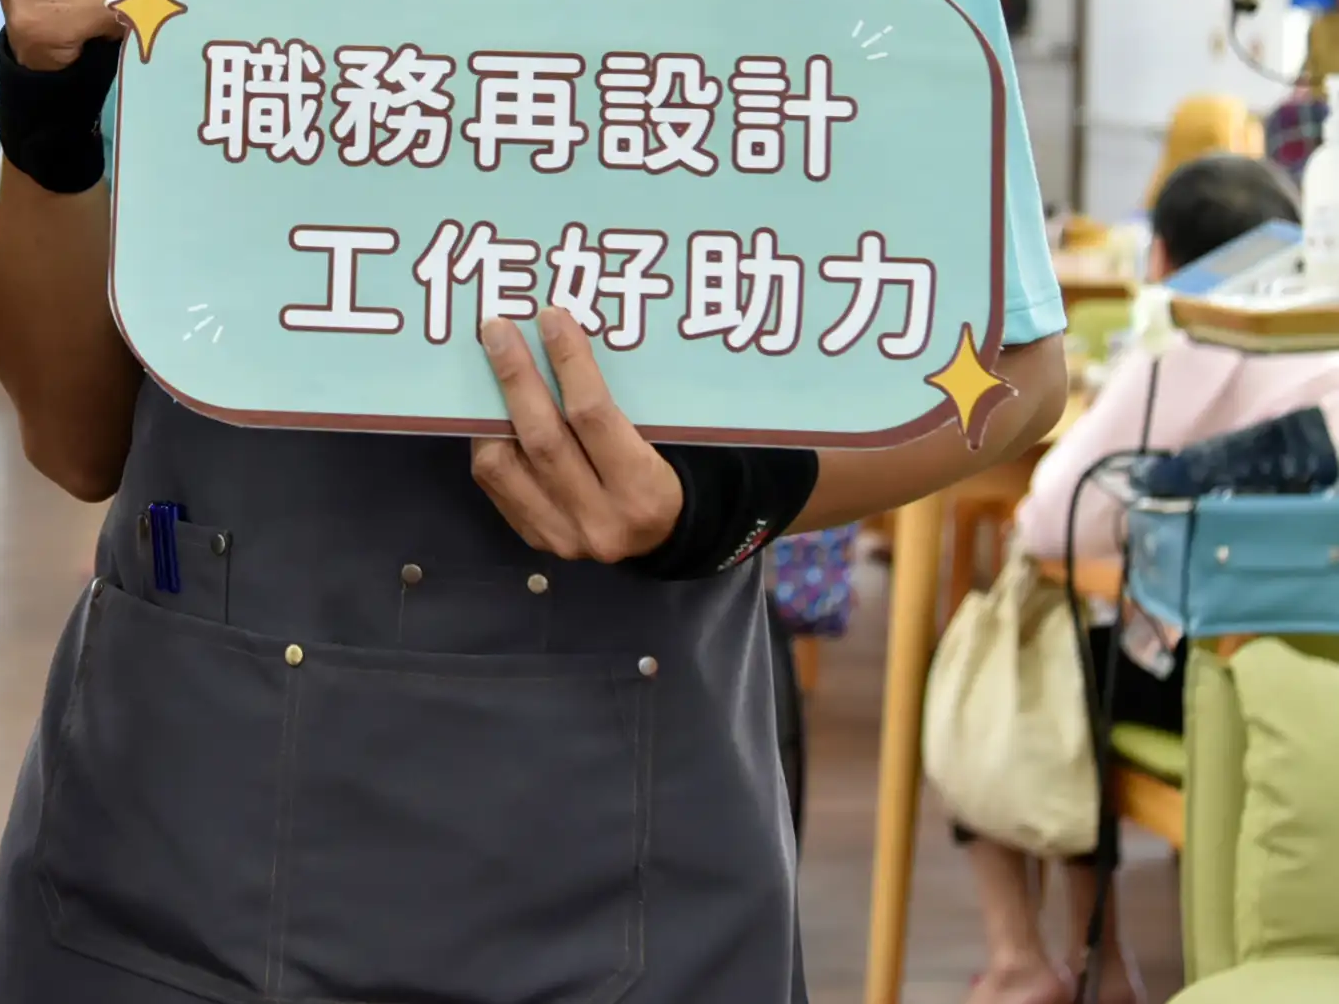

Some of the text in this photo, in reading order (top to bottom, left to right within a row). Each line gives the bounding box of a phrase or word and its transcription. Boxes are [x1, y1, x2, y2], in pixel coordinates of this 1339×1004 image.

[197, 37, 859, 182] 職務再設計
[278, 219, 937, 360] 工作好助力
